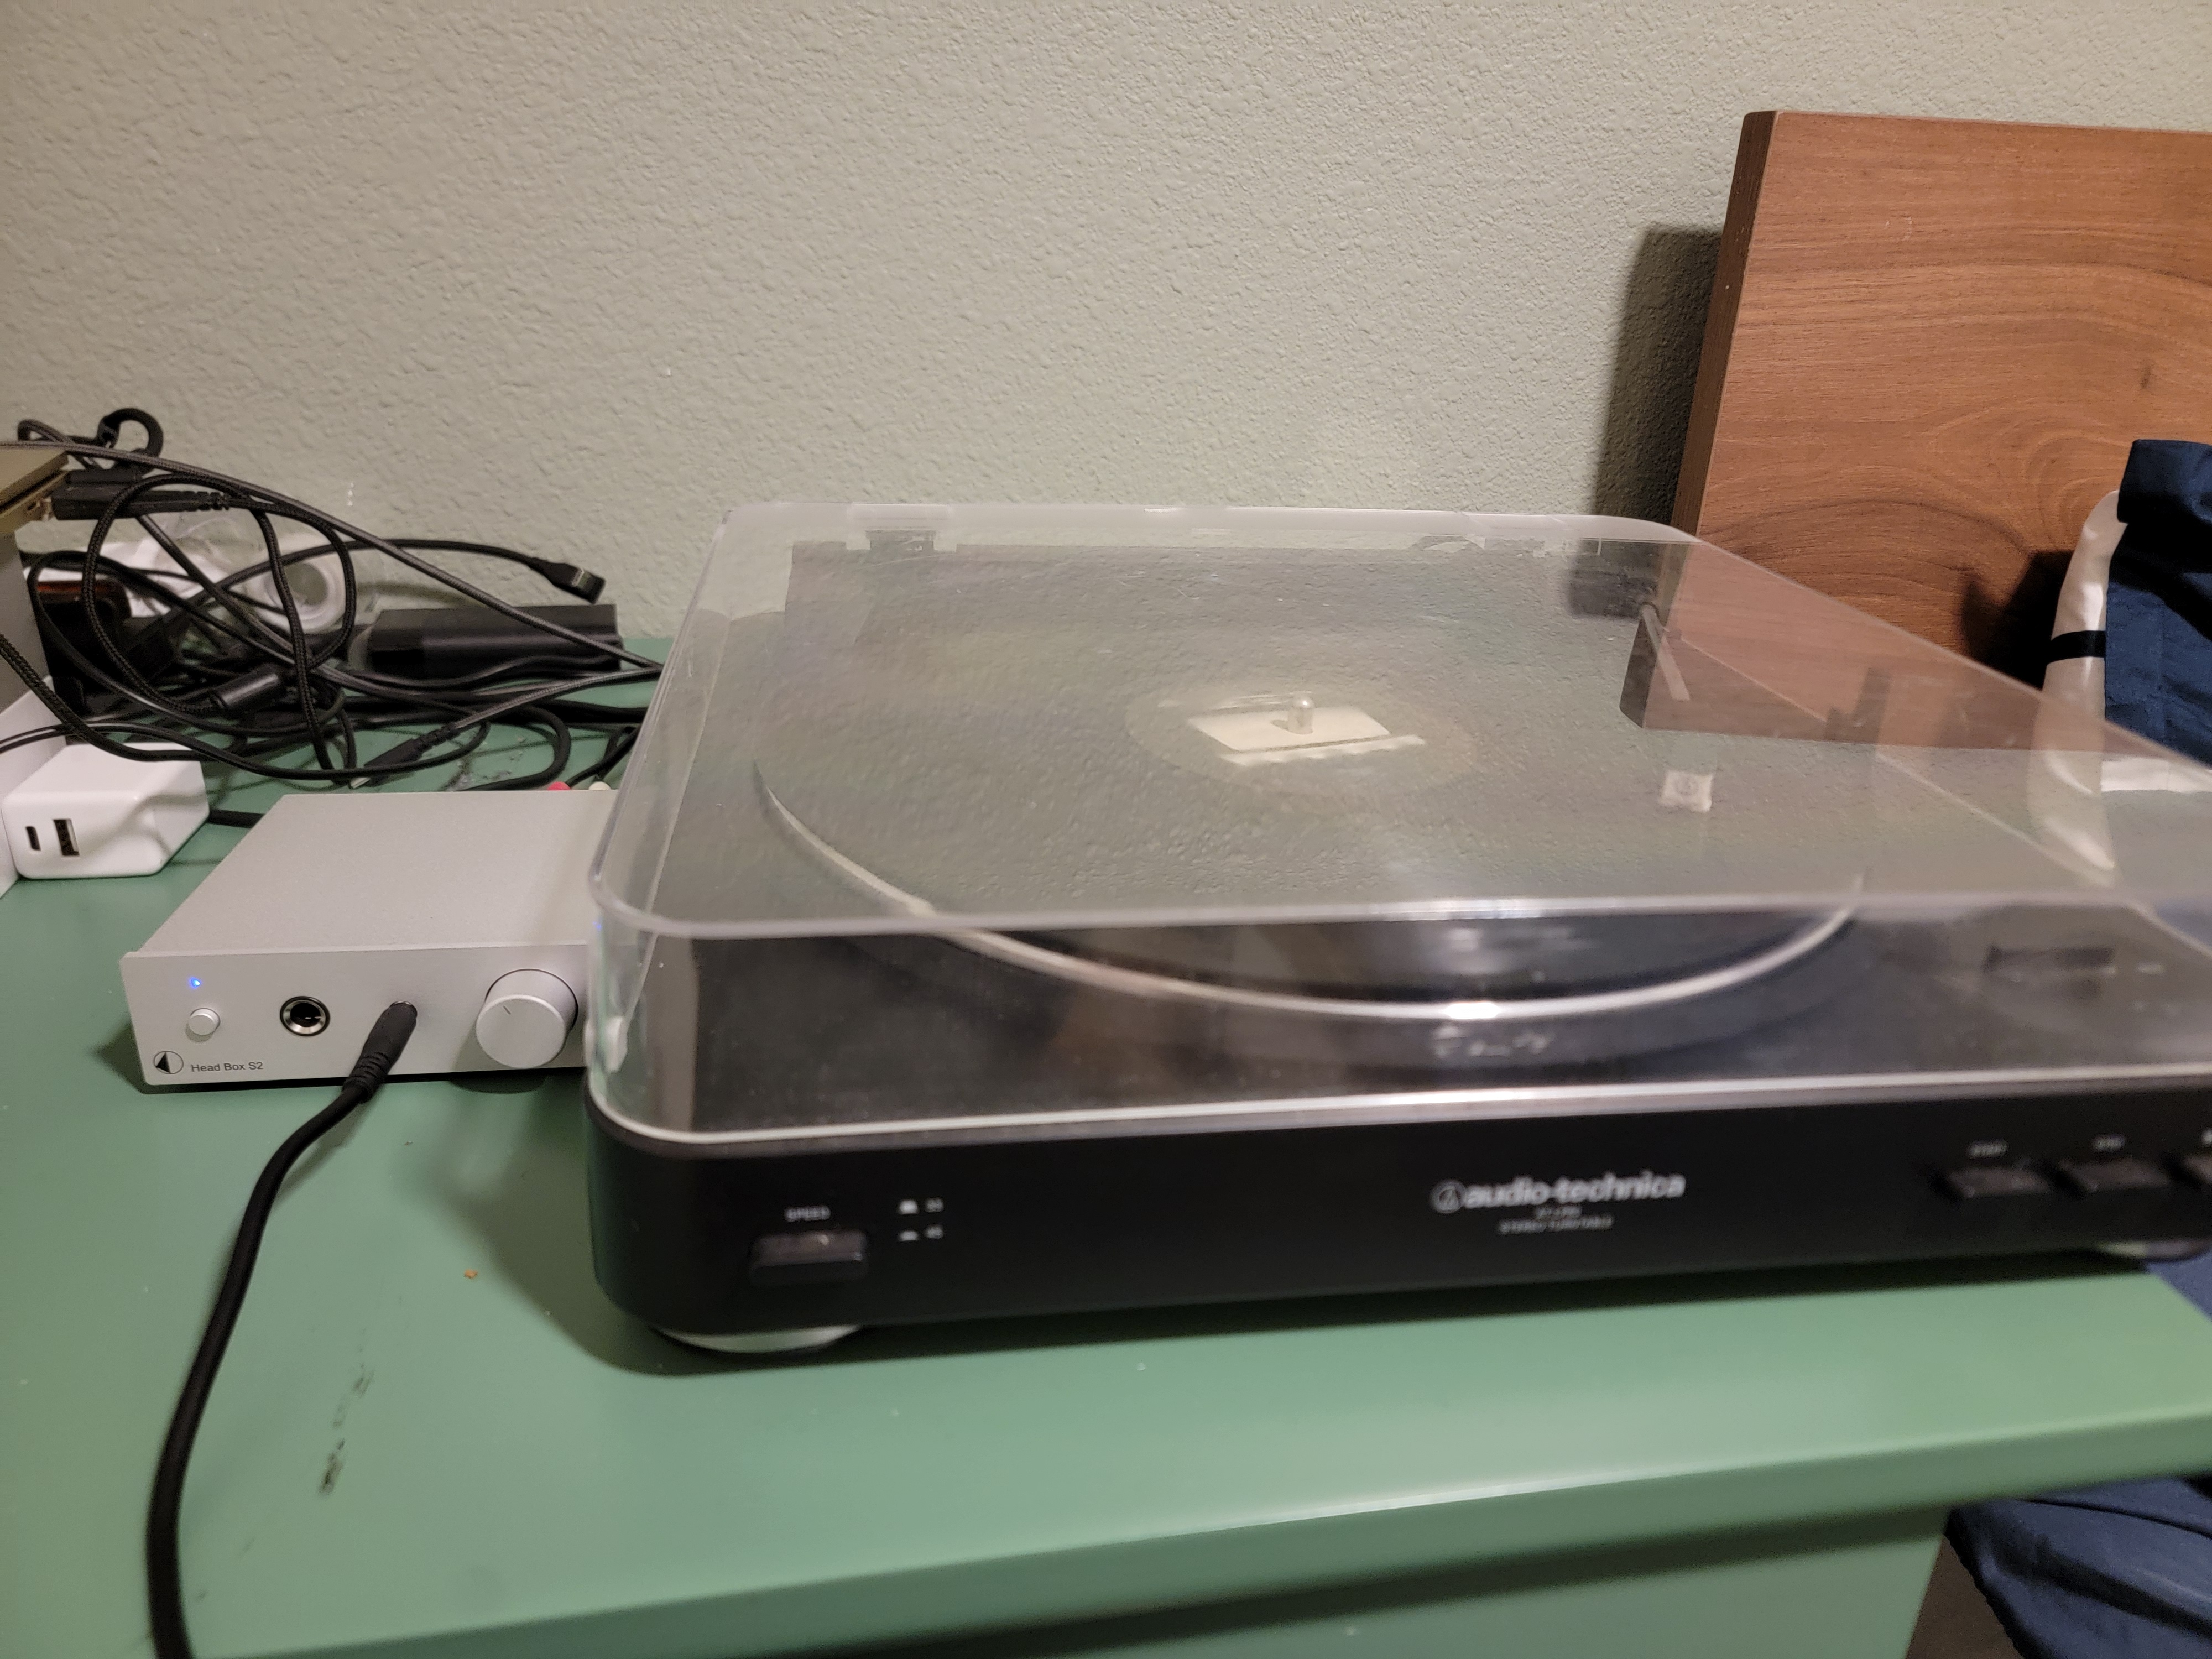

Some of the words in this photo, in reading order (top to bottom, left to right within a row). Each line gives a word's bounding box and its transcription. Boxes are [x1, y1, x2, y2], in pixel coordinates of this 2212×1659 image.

[224, 1062, 246, 1071] Box
[249, 1062, 264, 1070] S2
[1464, 1171, 1686, 1209] audio-technica
